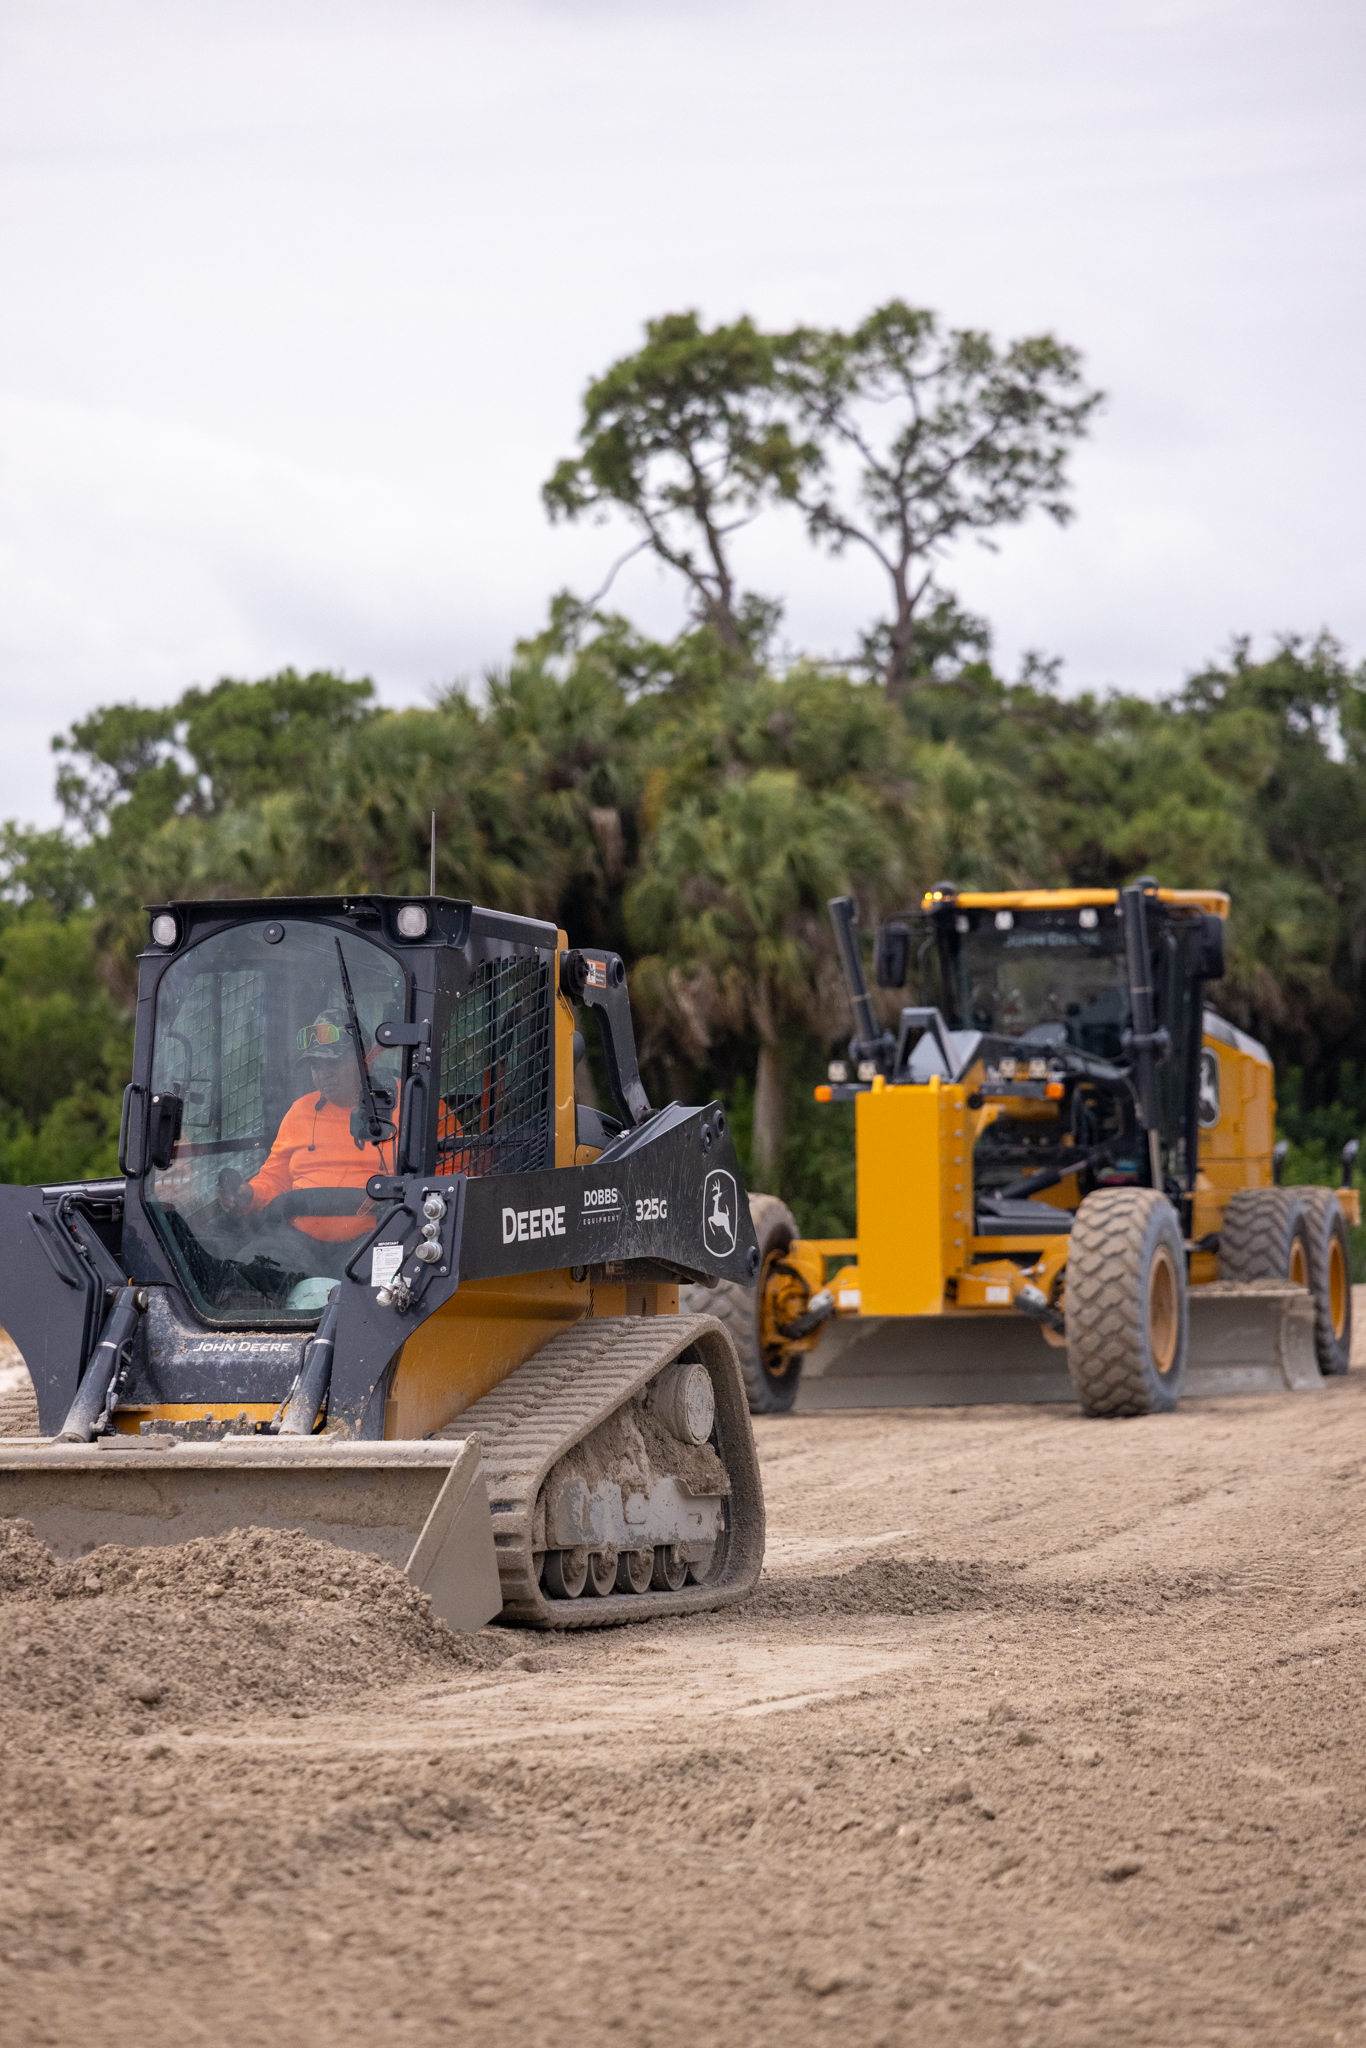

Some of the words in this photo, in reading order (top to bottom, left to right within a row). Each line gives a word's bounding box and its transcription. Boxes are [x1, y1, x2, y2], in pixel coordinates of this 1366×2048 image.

[584, 1188, 618, 1207] DOBBS
[635, 1198, 668, 1222] 325G
[502, 1205, 566, 1244] DEERE
[583, 1214, 619, 1226] EQUIPMENT
[193, 1341, 236, 1352] JOHN
[238, 1341, 292, 1352] DEERE
